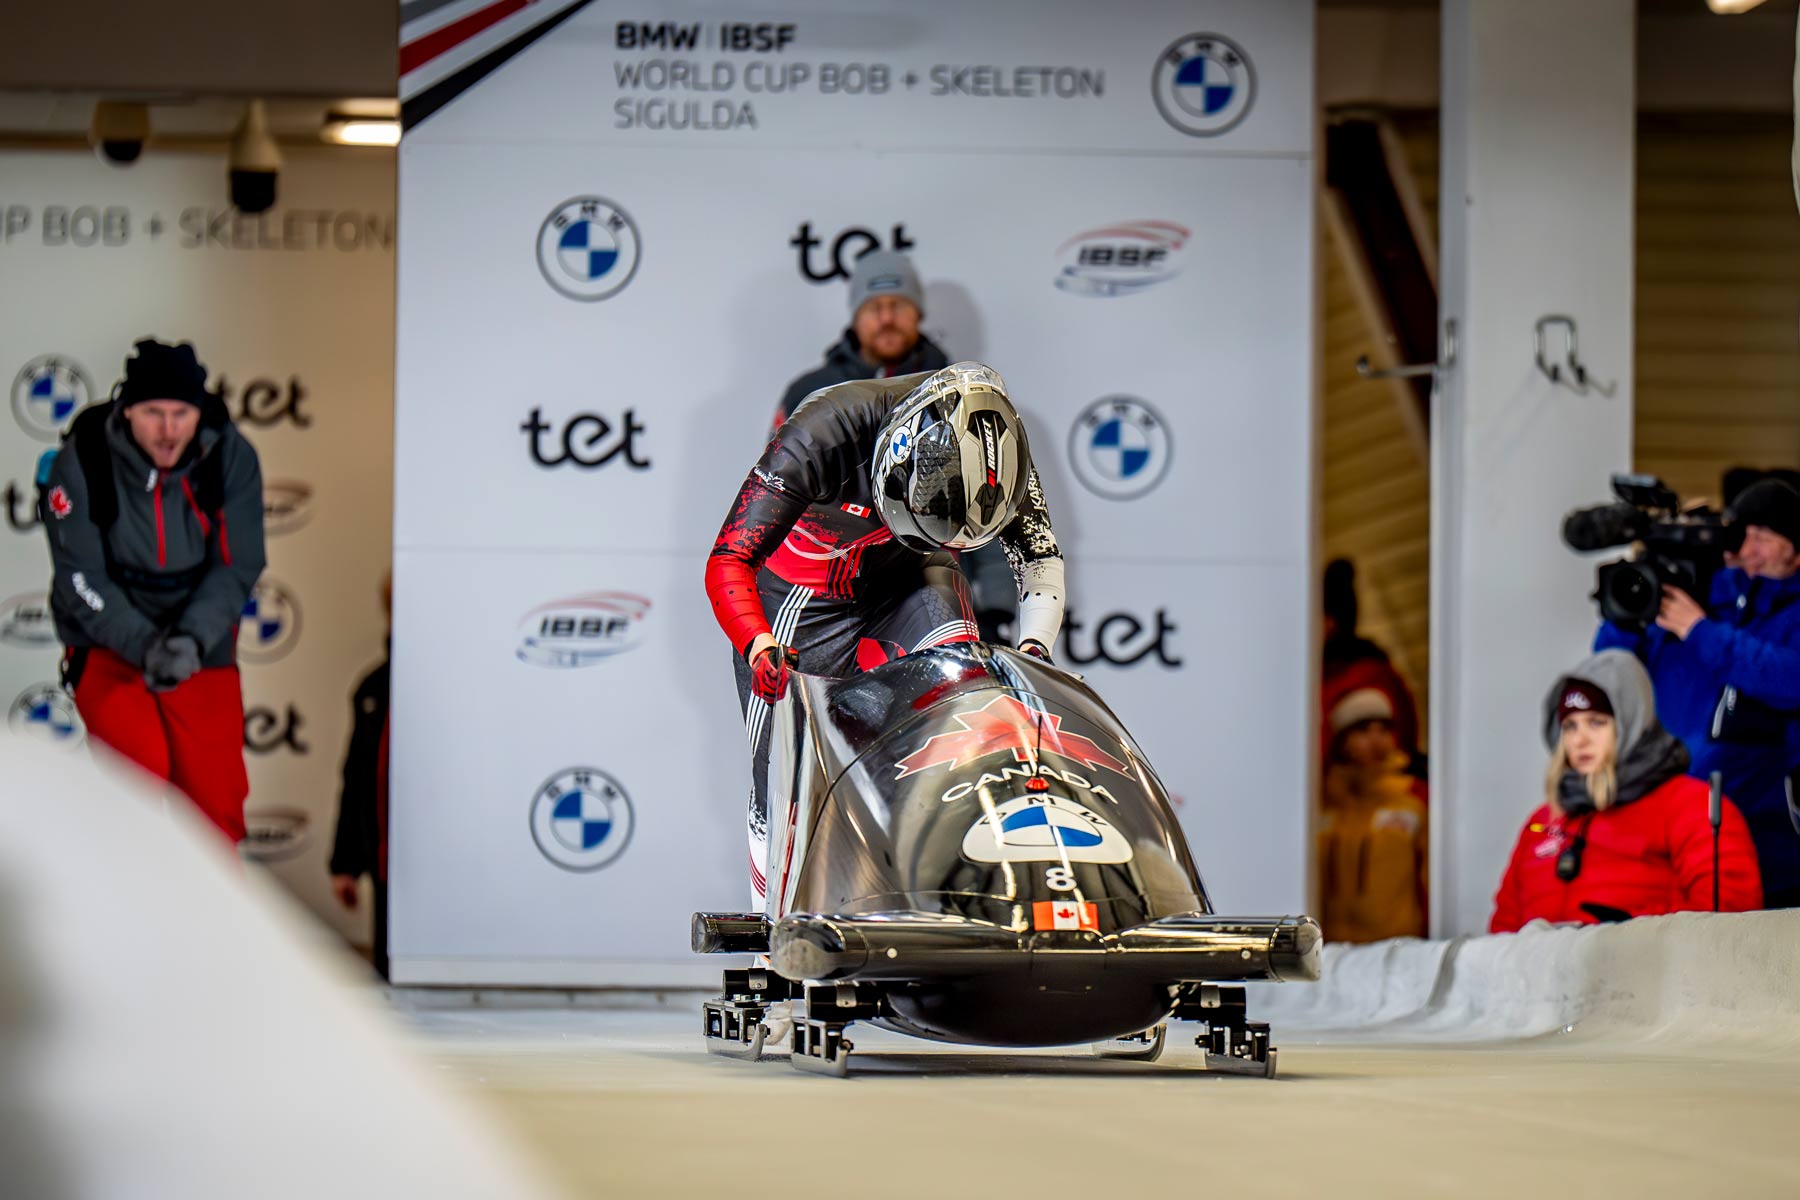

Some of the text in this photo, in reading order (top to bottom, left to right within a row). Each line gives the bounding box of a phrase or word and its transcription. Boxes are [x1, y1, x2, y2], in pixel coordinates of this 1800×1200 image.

[615, 20, 798, 53] BMW IBSF
[613, 59, 736, 92] WORLD
[743, 60, 812, 94] CUP
[818, 63, 891, 95] BOB
[929, 63, 1105, 98] SKELETON
[613, 97, 759, 131] SIGULDA
[0, 205, 33, 243] P
[42, 204, 132, 247] BOB
[520, 406, 651, 471] tet
[1062, 608, 1183, 668] tet
[941, 764, 1119, 804] CANADA
[1045, 867, 1077, 891] 8
